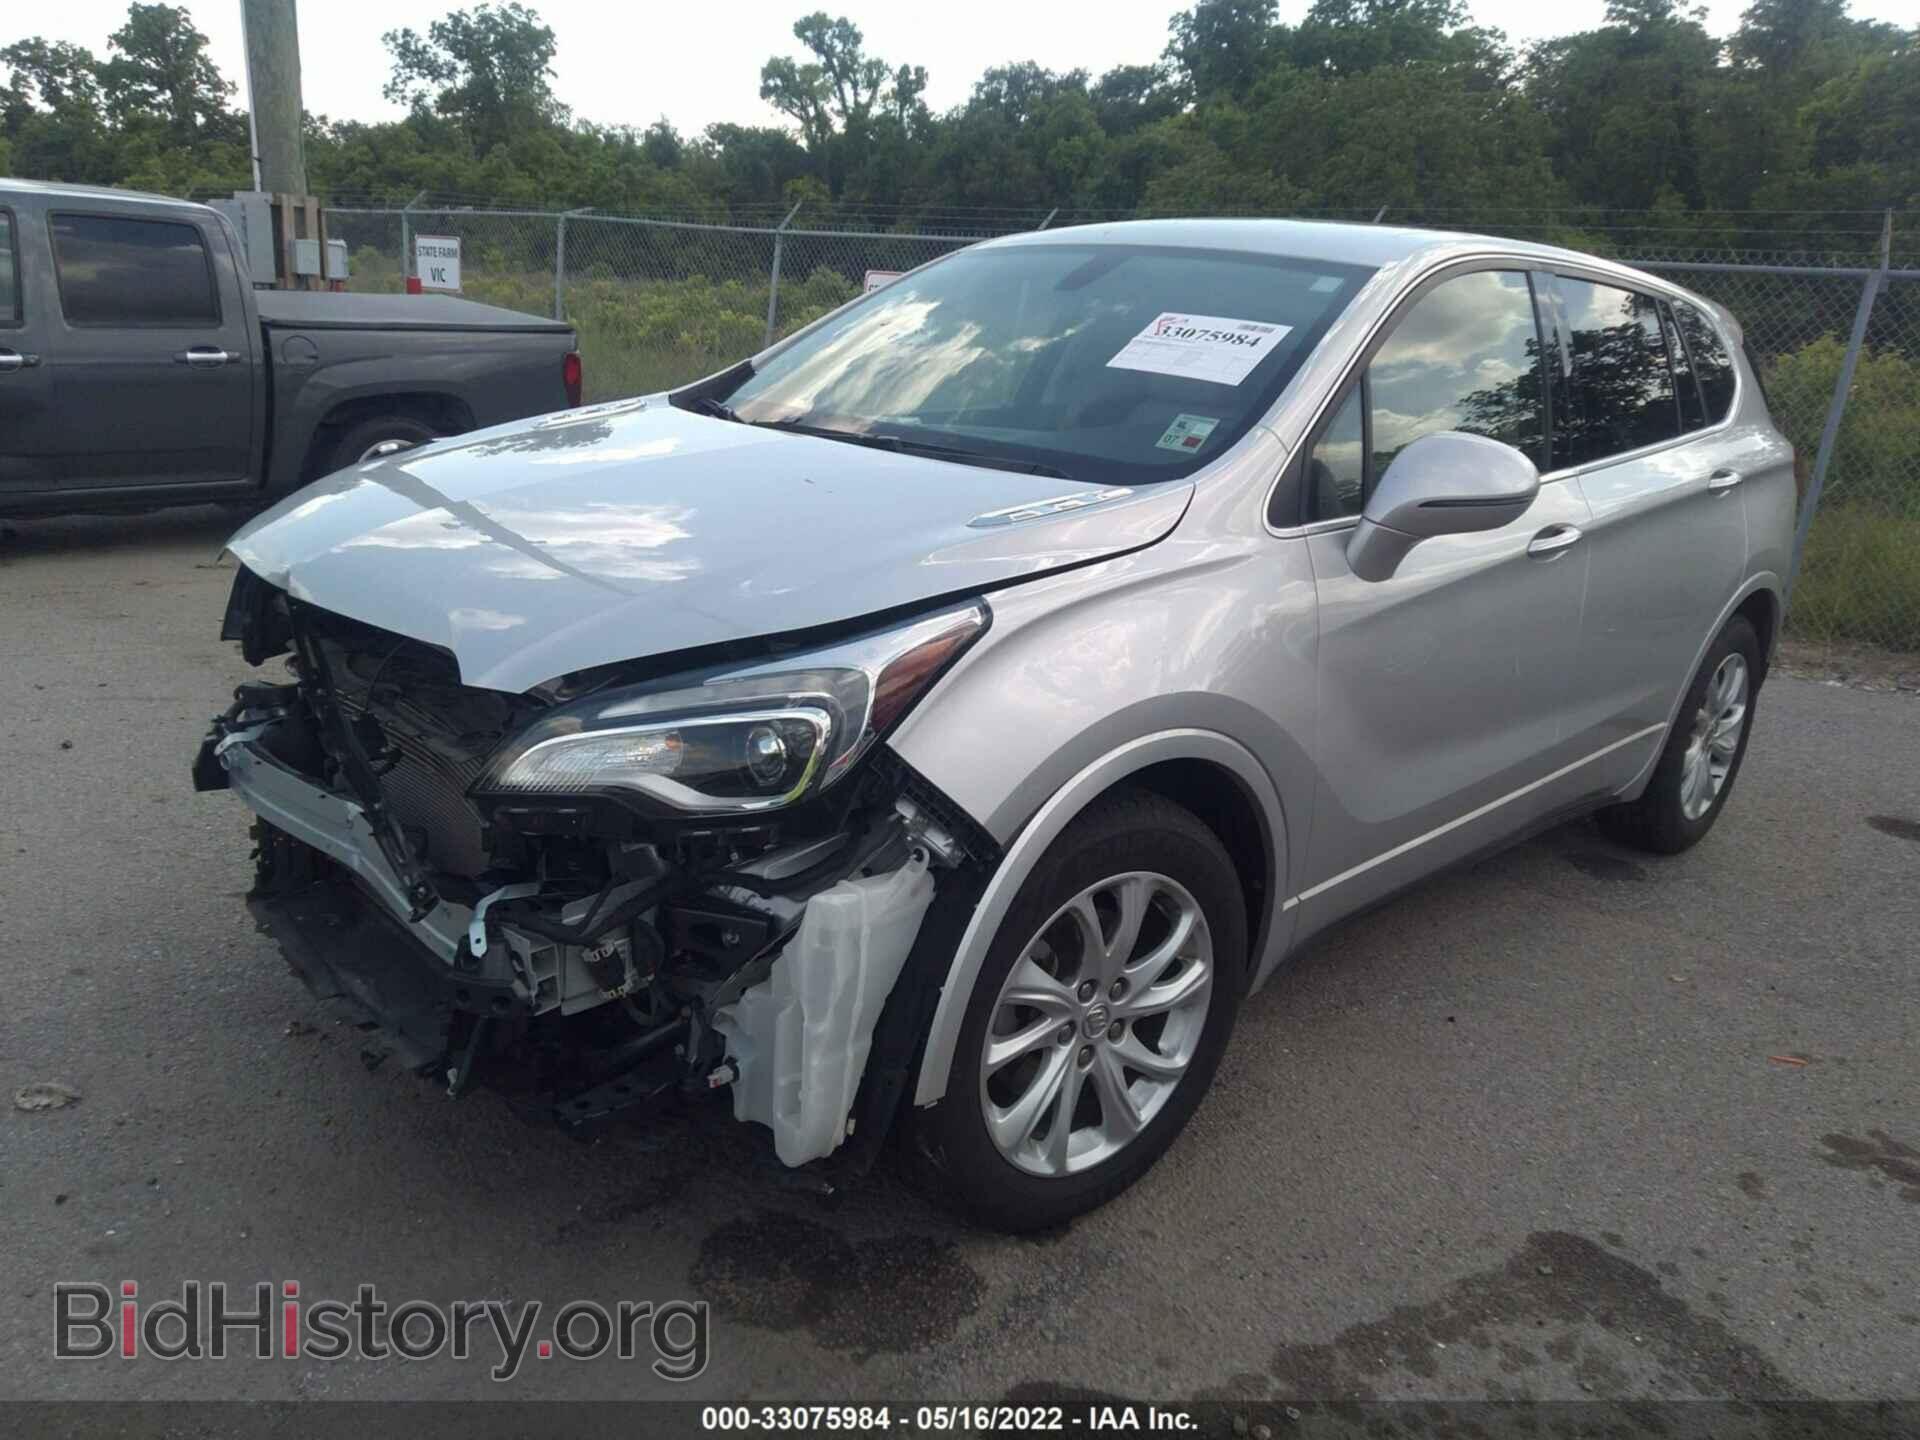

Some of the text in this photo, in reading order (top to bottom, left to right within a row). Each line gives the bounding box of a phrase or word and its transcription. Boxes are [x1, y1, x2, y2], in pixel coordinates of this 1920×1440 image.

[417, 246, 458, 258] STATE FARM
[430, 267, 446, 283] VIC
[1162, 325, 1262, 348] 33075984
